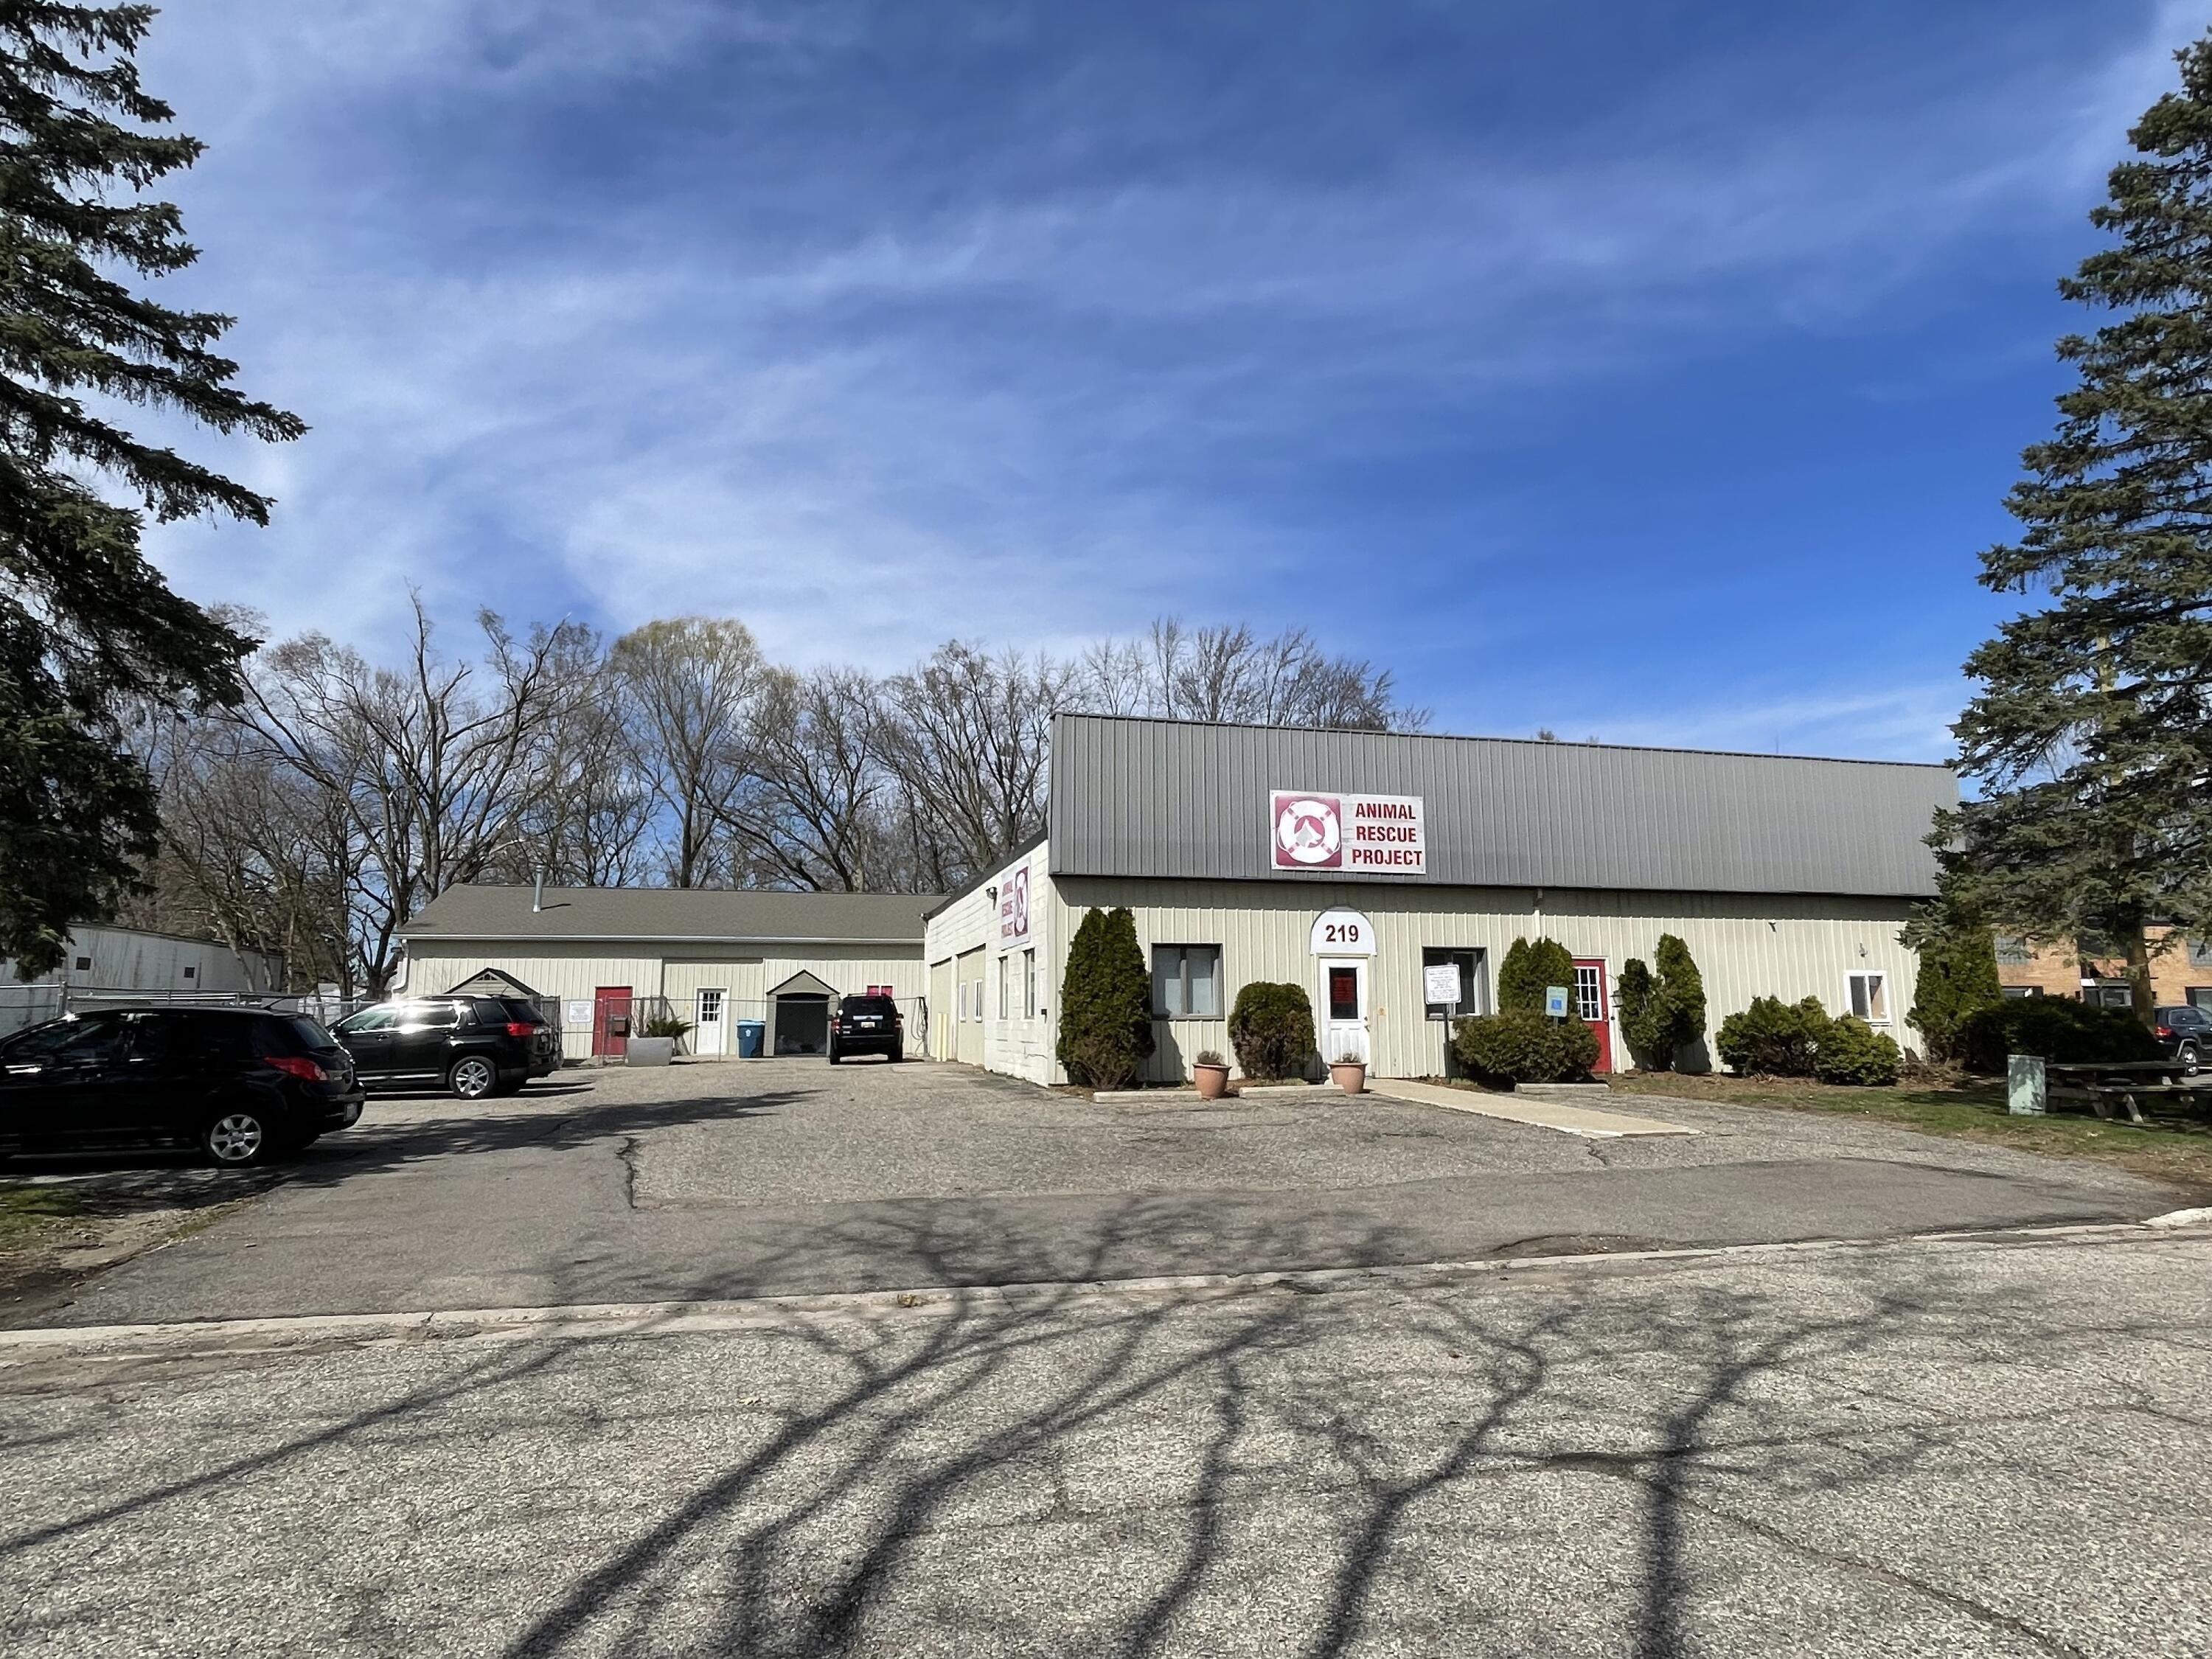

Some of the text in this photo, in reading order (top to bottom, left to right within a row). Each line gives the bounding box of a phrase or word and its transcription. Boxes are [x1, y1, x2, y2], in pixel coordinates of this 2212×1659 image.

[1355, 803, 1416, 820] ANIMAL
[1356, 826, 1416, 843] RESCUE
[1352, 849, 1422, 866] PROJECT
[1326, 925, 1359, 942] 219
